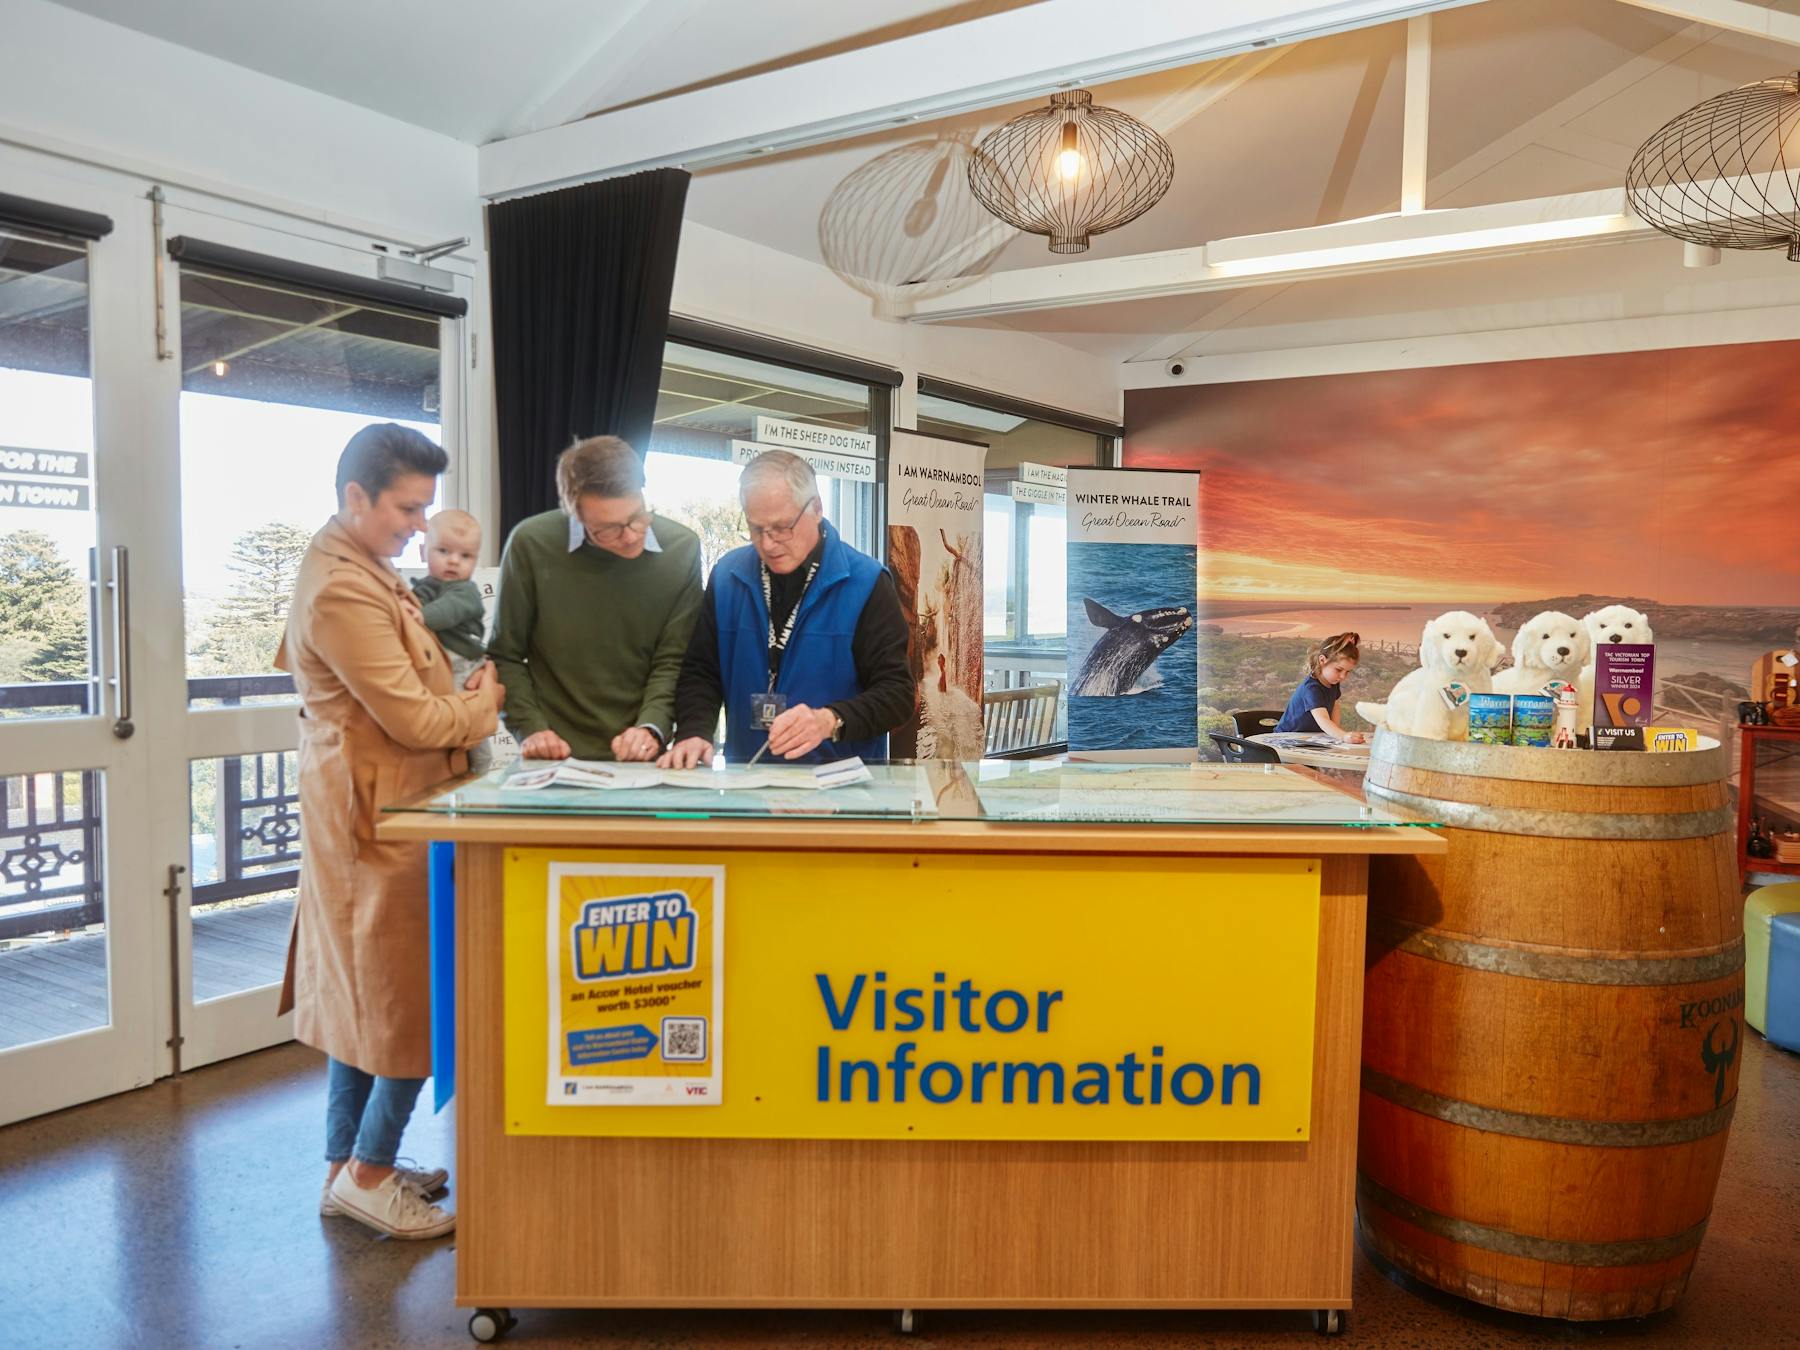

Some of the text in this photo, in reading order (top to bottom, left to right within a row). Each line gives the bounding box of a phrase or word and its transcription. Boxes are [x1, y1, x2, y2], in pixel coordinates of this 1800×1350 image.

[764, 424, 871, 451] I'M THE SHEEP DOG THAT
[37, 453, 77, 473] THE
[837, 461, 871, 476] INSTEAD
[904, 465, 918, 478] AM
[919, 467, 982, 487] WARRNAMBOOL
[1041, 470, 1051, 480] THE
[17, 485, 79, 506] TOWN
[903, 488, 979, 512] Great Ocean Road
[1016, 486, 1027, 497] THE
[1075, 494, 1191, 507] WINTER WHALE TRAIL
[1081, 511, 1186, 532] Great Ocean Road
[1611, 675, 1641, 684] SILVER
[1604, 728, 1636, 737] VISIT US
[1655, 739, 1687, 752] WIN
[589, 898, 682, 927] ENTER TO
[579, 917, 691, 976] WIN
[571, 992, 585, 1002] an
[624, 984, 654, 996] Hotel
[656, 979, 703, 992] voucher
[597, 1000, 631, 1013] worth
[815, 971, 1063, 1033] Visitor
[816, 1042, 1262, 1106] Information
